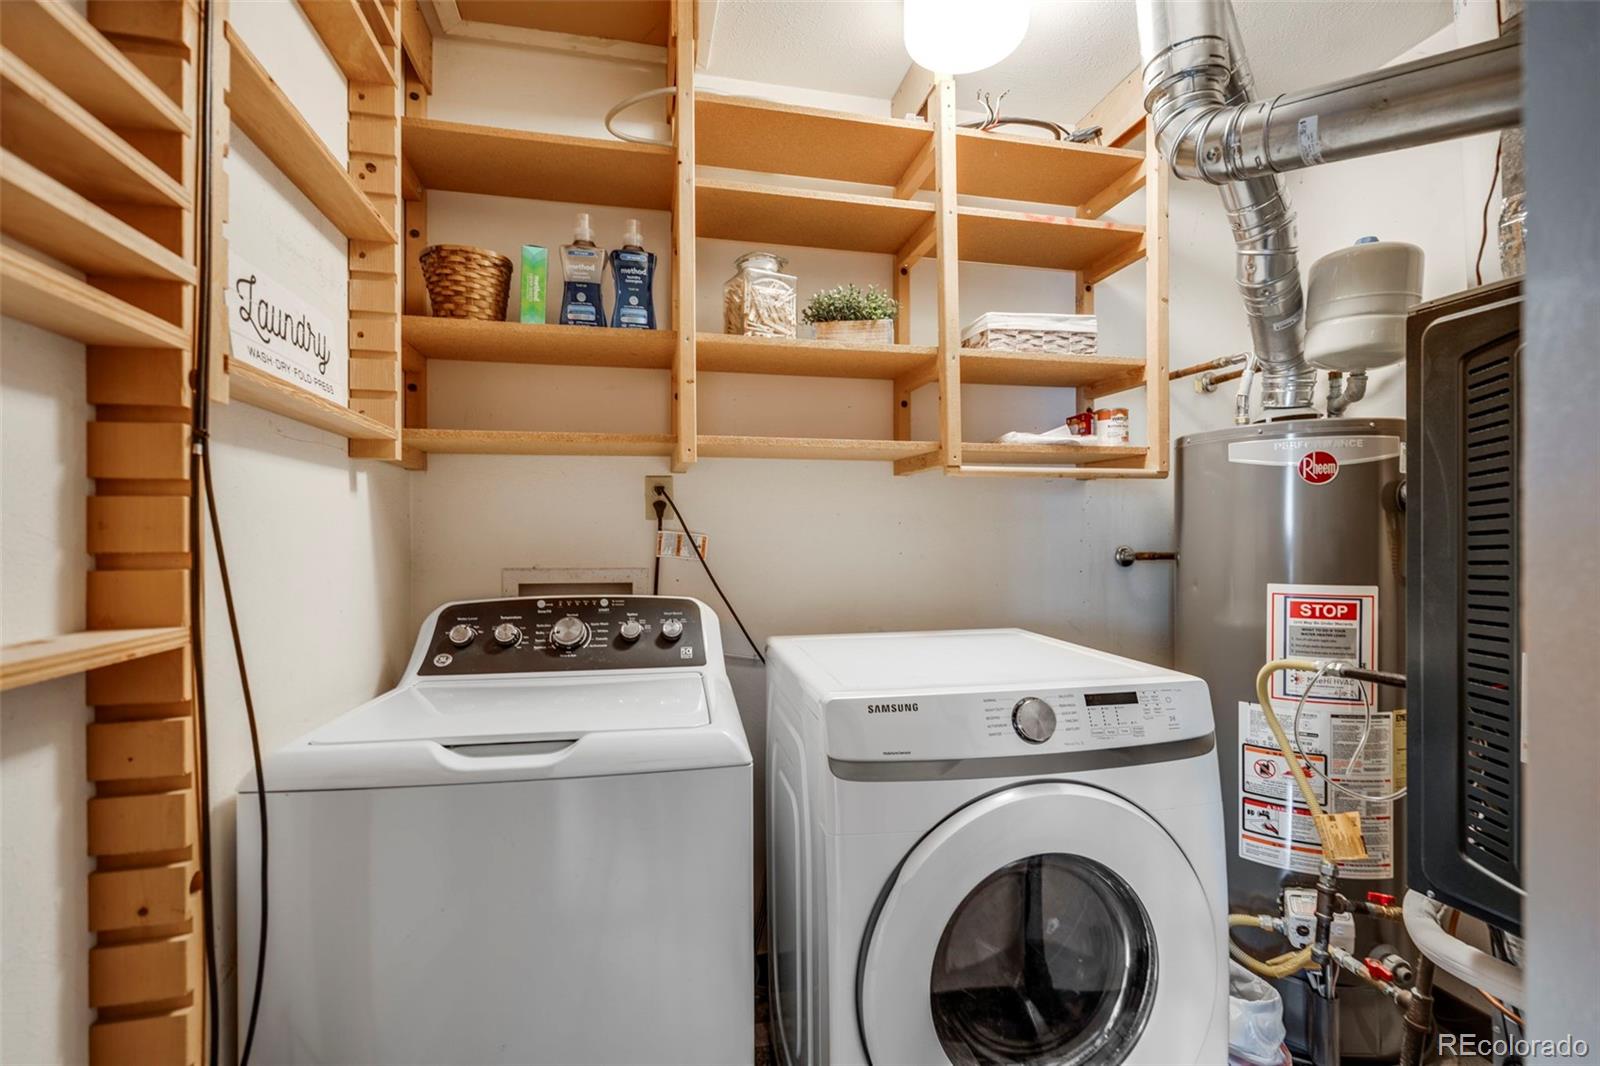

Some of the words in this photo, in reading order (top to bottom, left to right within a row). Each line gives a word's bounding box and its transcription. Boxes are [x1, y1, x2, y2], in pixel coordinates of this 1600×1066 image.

[236, 275, 331, 375] Laundry
[247, 345, 273, 366] WASH
[293, 367, 312, 385] FOLD
[1273, 439, 1364, 451] PERFORMANCE
[1303, 451, 1336, 479] Rheem
[1299, 603, 1349, 618] STOP
[867, 702, 919, 714] SAMSUNG
